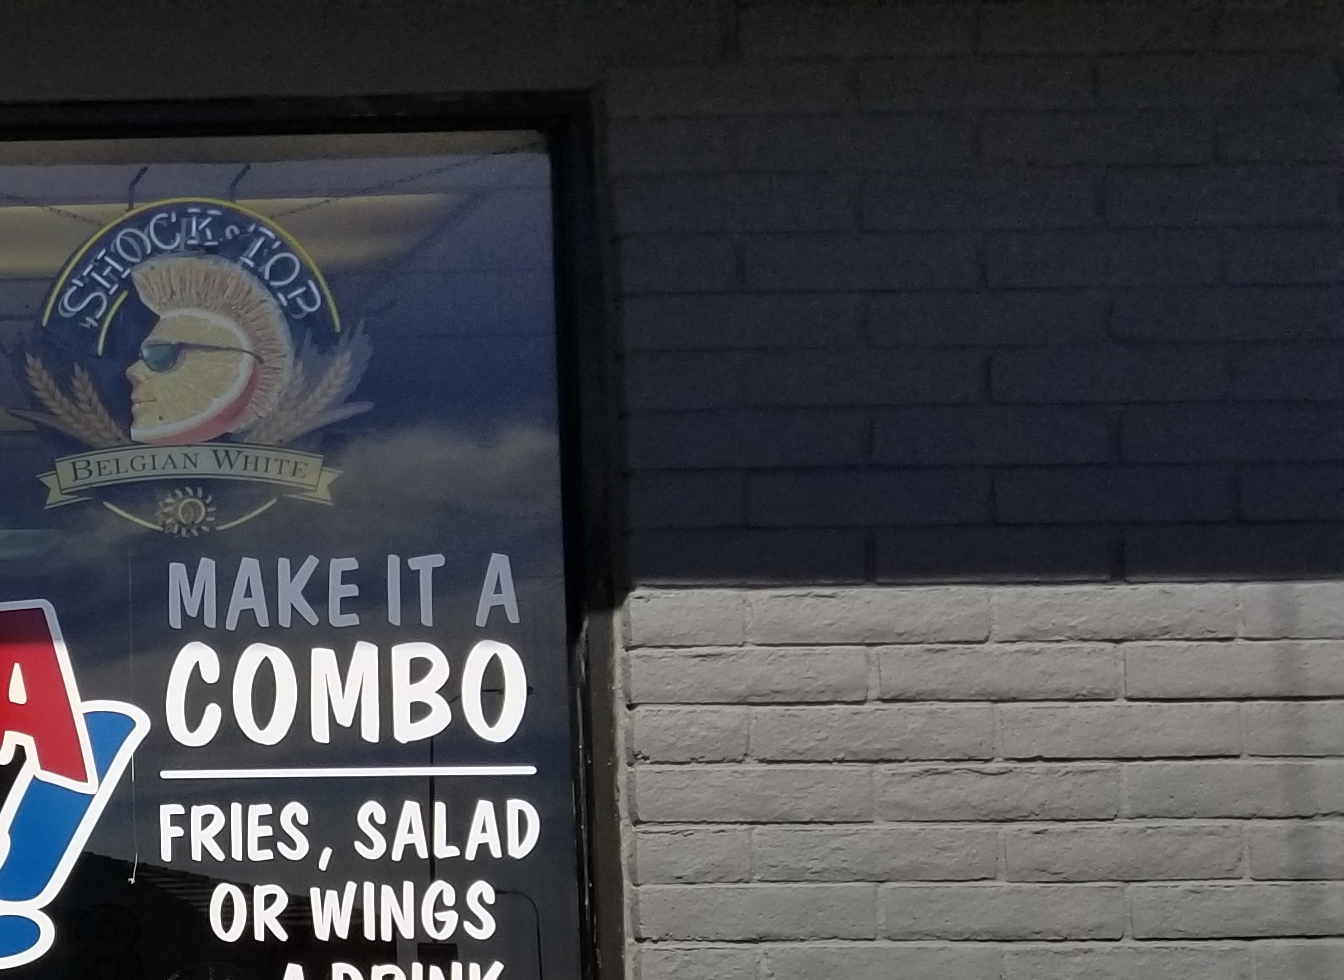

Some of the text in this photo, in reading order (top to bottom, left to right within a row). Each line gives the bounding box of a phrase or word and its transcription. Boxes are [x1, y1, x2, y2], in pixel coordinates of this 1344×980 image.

[59, 208, 322, 328] SHOCK TOP
[69, 448, 309, 482] BELGIAN WHITE
[169, 552, 520, 631] MAKE IT A
[166, 640, 528, 747] COMBO
[160, 798, 541, 872] FRIES, SALAD
[209, 880, 496, 942] OR WINGS
